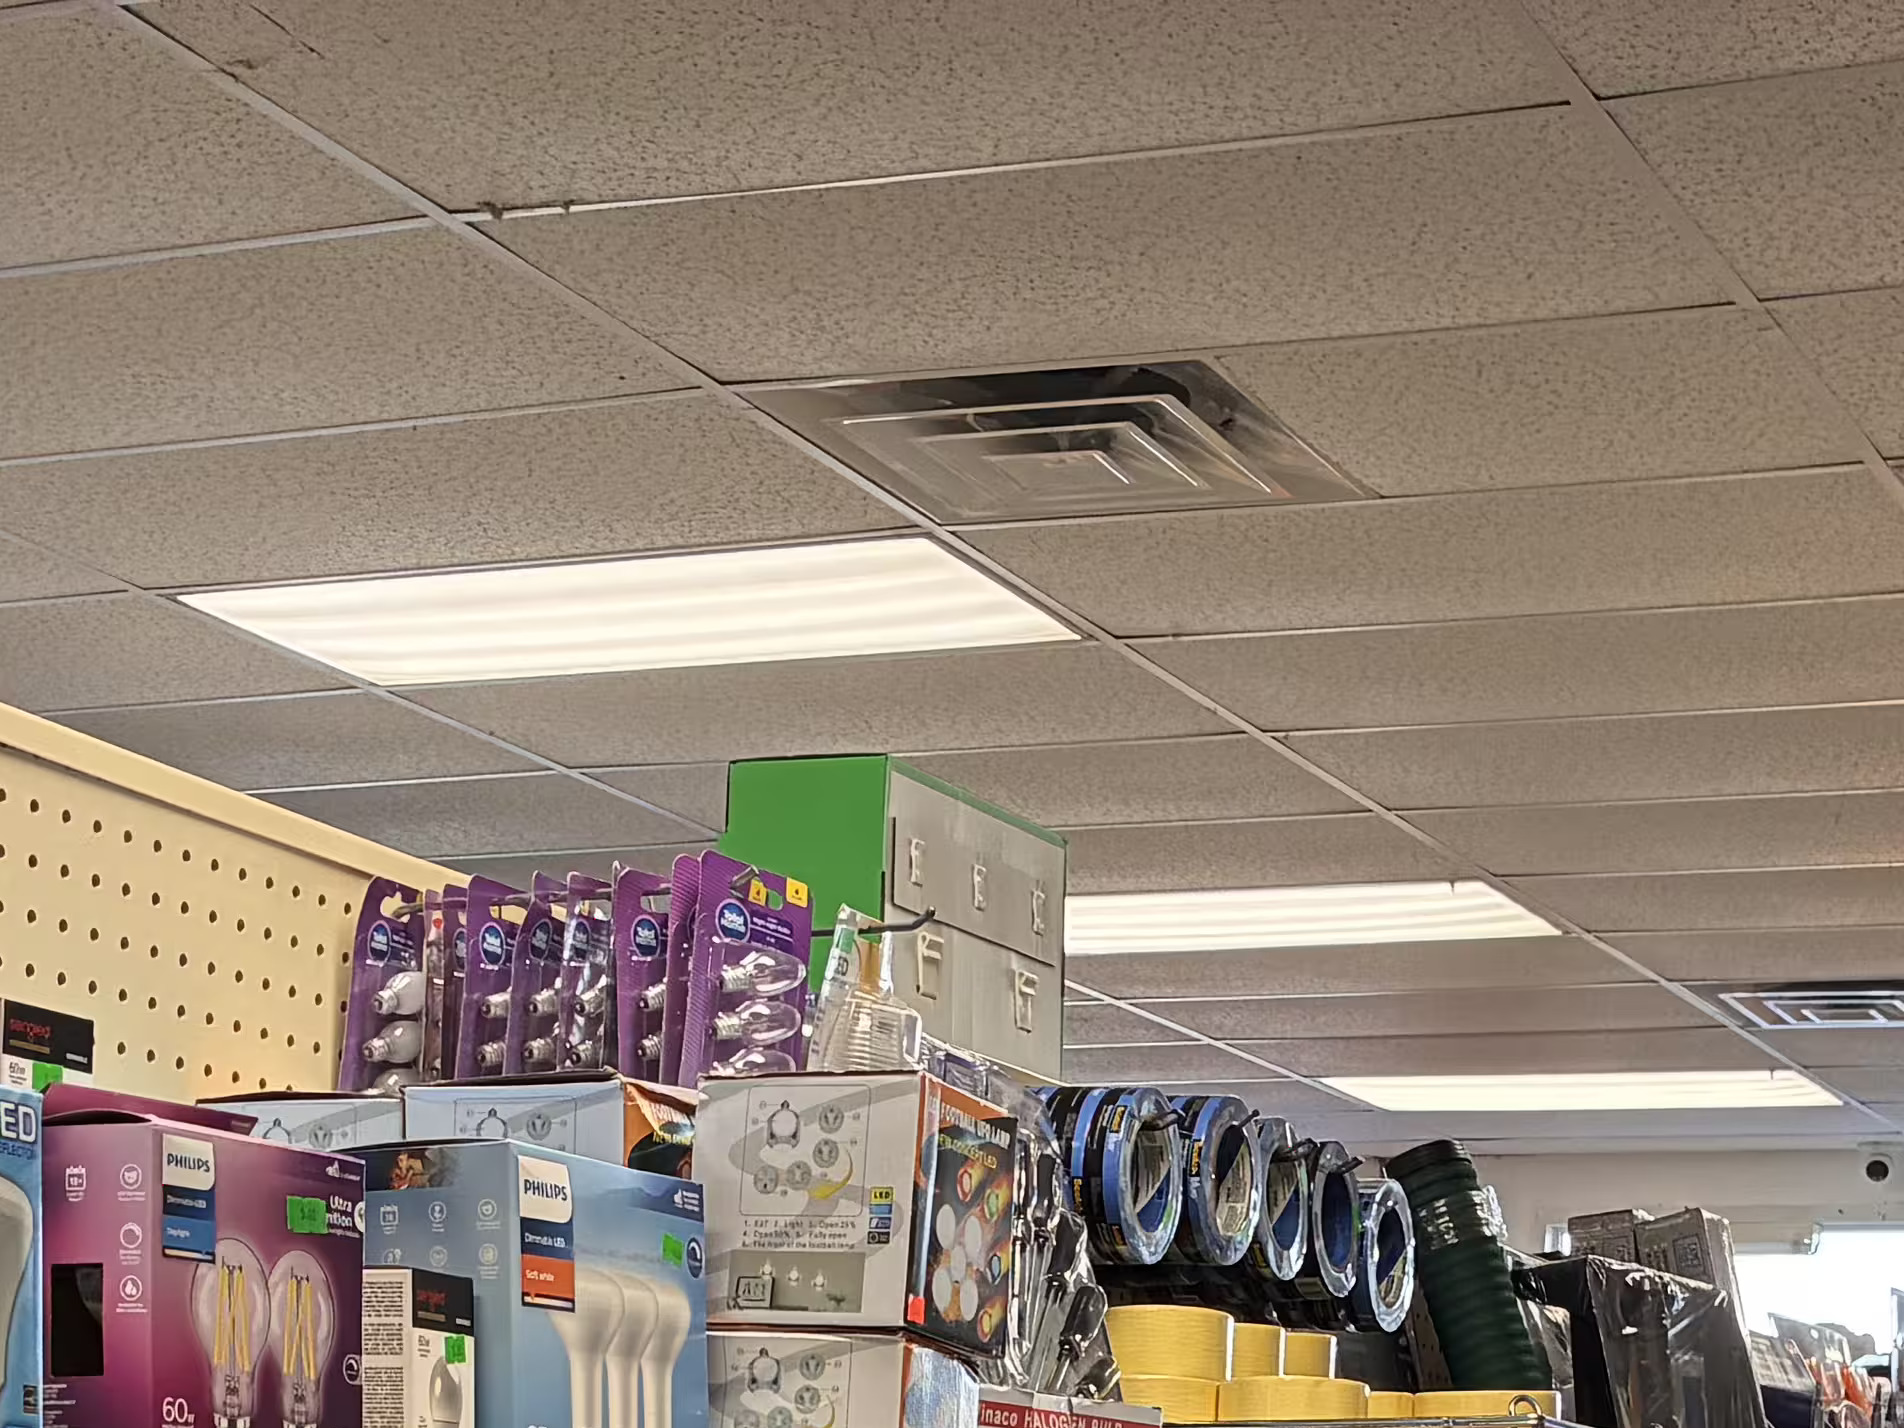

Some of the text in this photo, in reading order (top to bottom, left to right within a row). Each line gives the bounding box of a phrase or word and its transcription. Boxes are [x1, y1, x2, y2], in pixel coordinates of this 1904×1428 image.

[166, 1152, 211, 1174] PHILIPS
[523, 1178, 569, 1203] PHILIPS
[872, 1191, 891, 1200] LED
[329, 1195, 353, 1213] Ultra
[980, 1408, 1019, 1428] inaco
